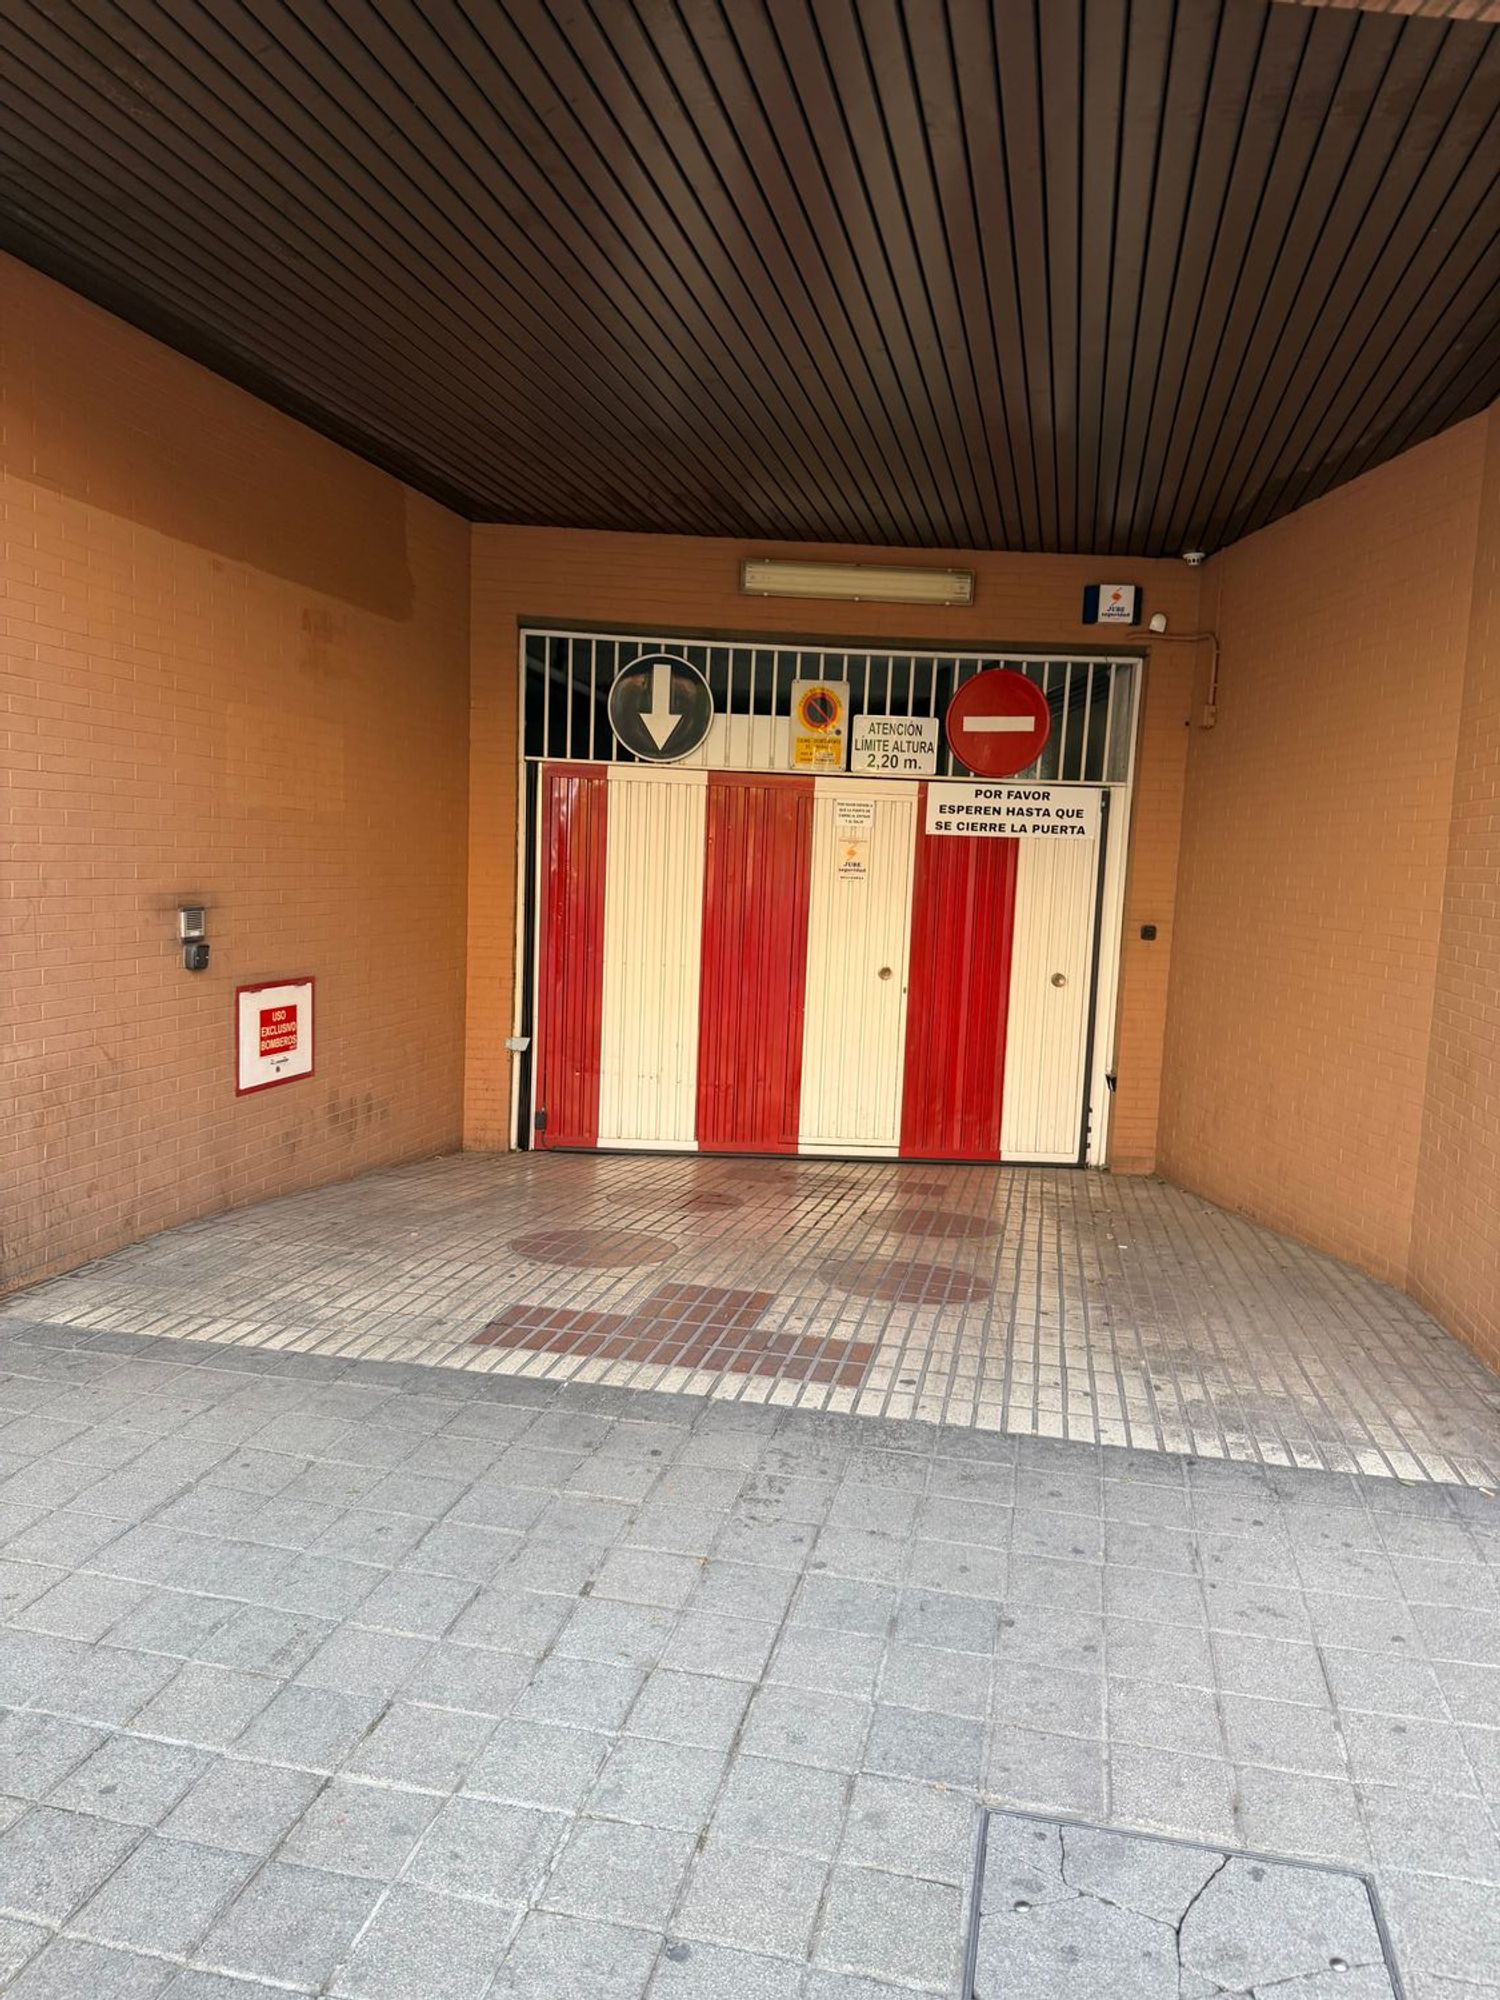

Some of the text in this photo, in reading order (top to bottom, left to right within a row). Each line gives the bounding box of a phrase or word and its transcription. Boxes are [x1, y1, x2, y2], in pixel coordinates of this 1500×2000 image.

[868, 720, 923, 736] ATENCIÓN
[854, 735, 935, 754] LÍMITE ALTURA
[867, 753, 922, 770] 2,20 m.
[975, 789, 1051, 801] POR FAVOR
[939, 804, 1084, 819] ESPEREN HASTA QUE
[935, 821, 1085, 835] SE CIERRE LA PUERTA
[271, 1010, 287, 1022] USO
[261, 1021, 296, 1037] EXCLUSIVO
[261, 1035, 297, 1051] BOMBEROS
